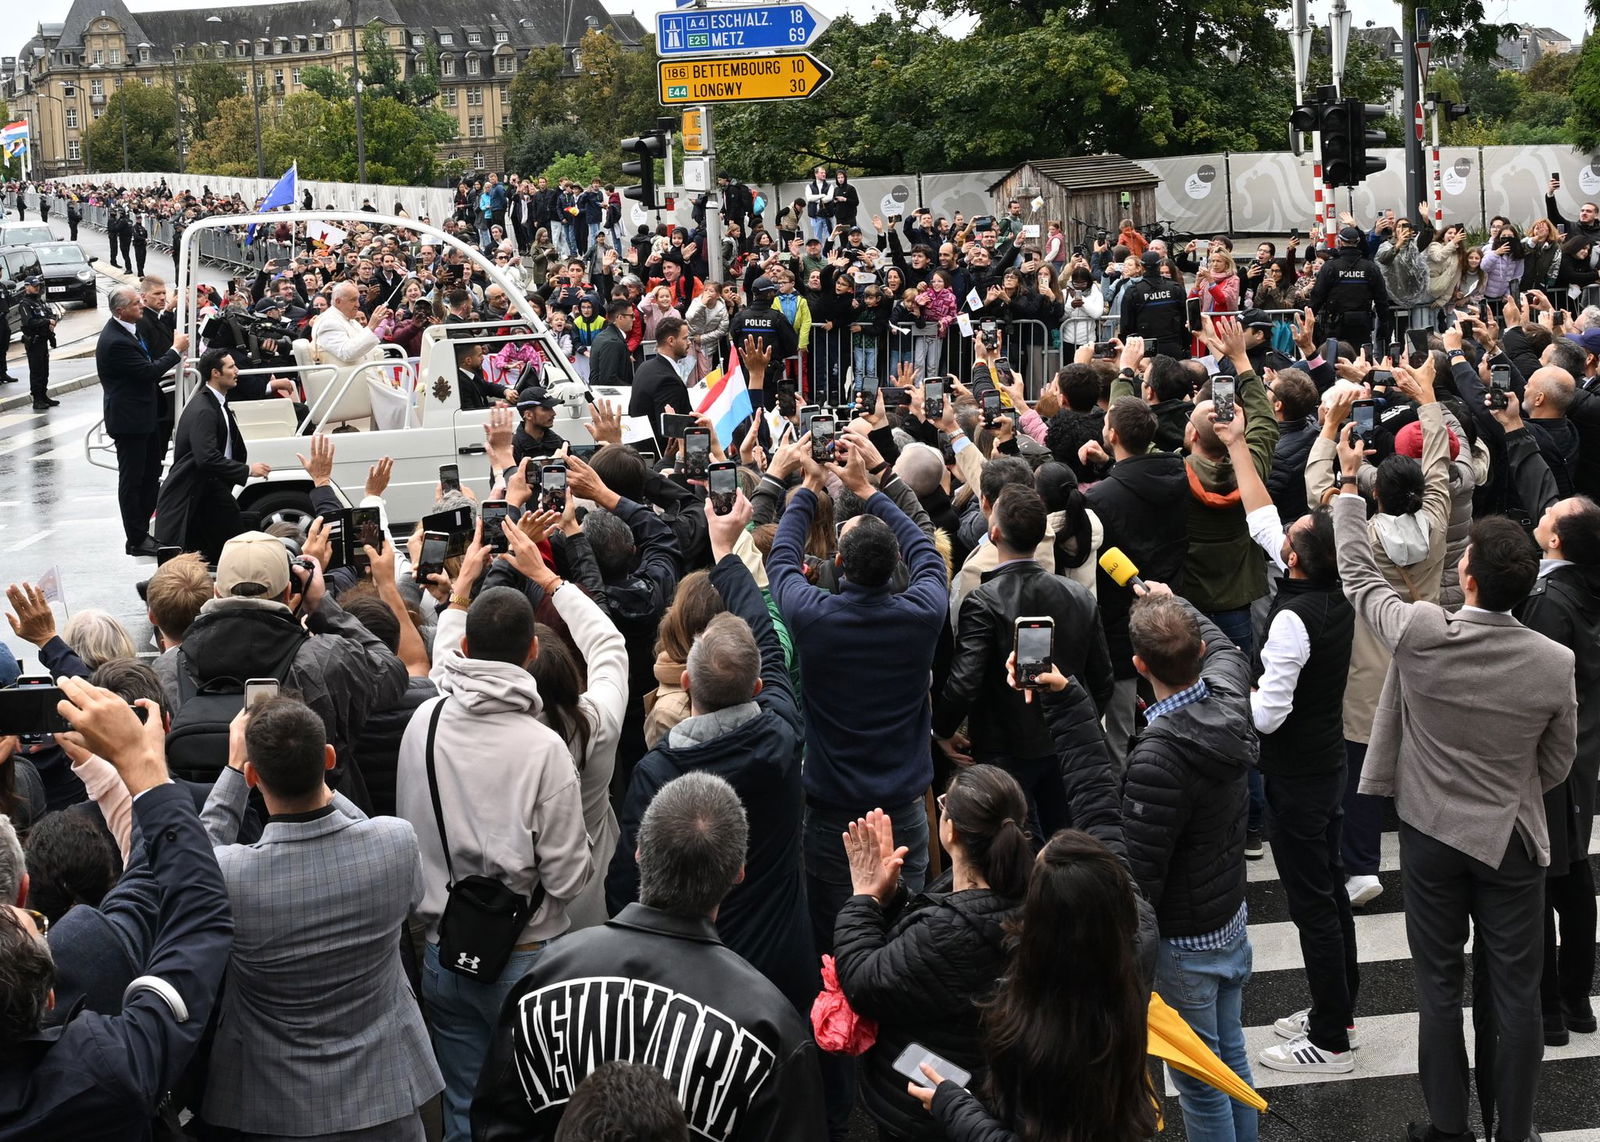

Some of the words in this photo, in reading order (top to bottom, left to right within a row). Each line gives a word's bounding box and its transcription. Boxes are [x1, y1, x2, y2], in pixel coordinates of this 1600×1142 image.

[711, 11, 773, 29] ESCH/ALZ.
[790, 9, 803, 24] 18
[689, 35, 707, 46] E25
[711, 31, 745, 47] METZ
[789, 27, 805, 42] 69
[667, 67, 686, 78] 186
[693, 60, 781, 79] BETTEMBOURG
[791, 59, 805, 73] 10
[668, 87, 687, 97] E44
[693, 81, 743, 98] LONGWY
[790, 78, 806, 93] 30
[1338, 270, 1365, 278] POLICE
[1144, 290, 1171, 301] POLICE
[745, 318, 772, 327] POLICE
